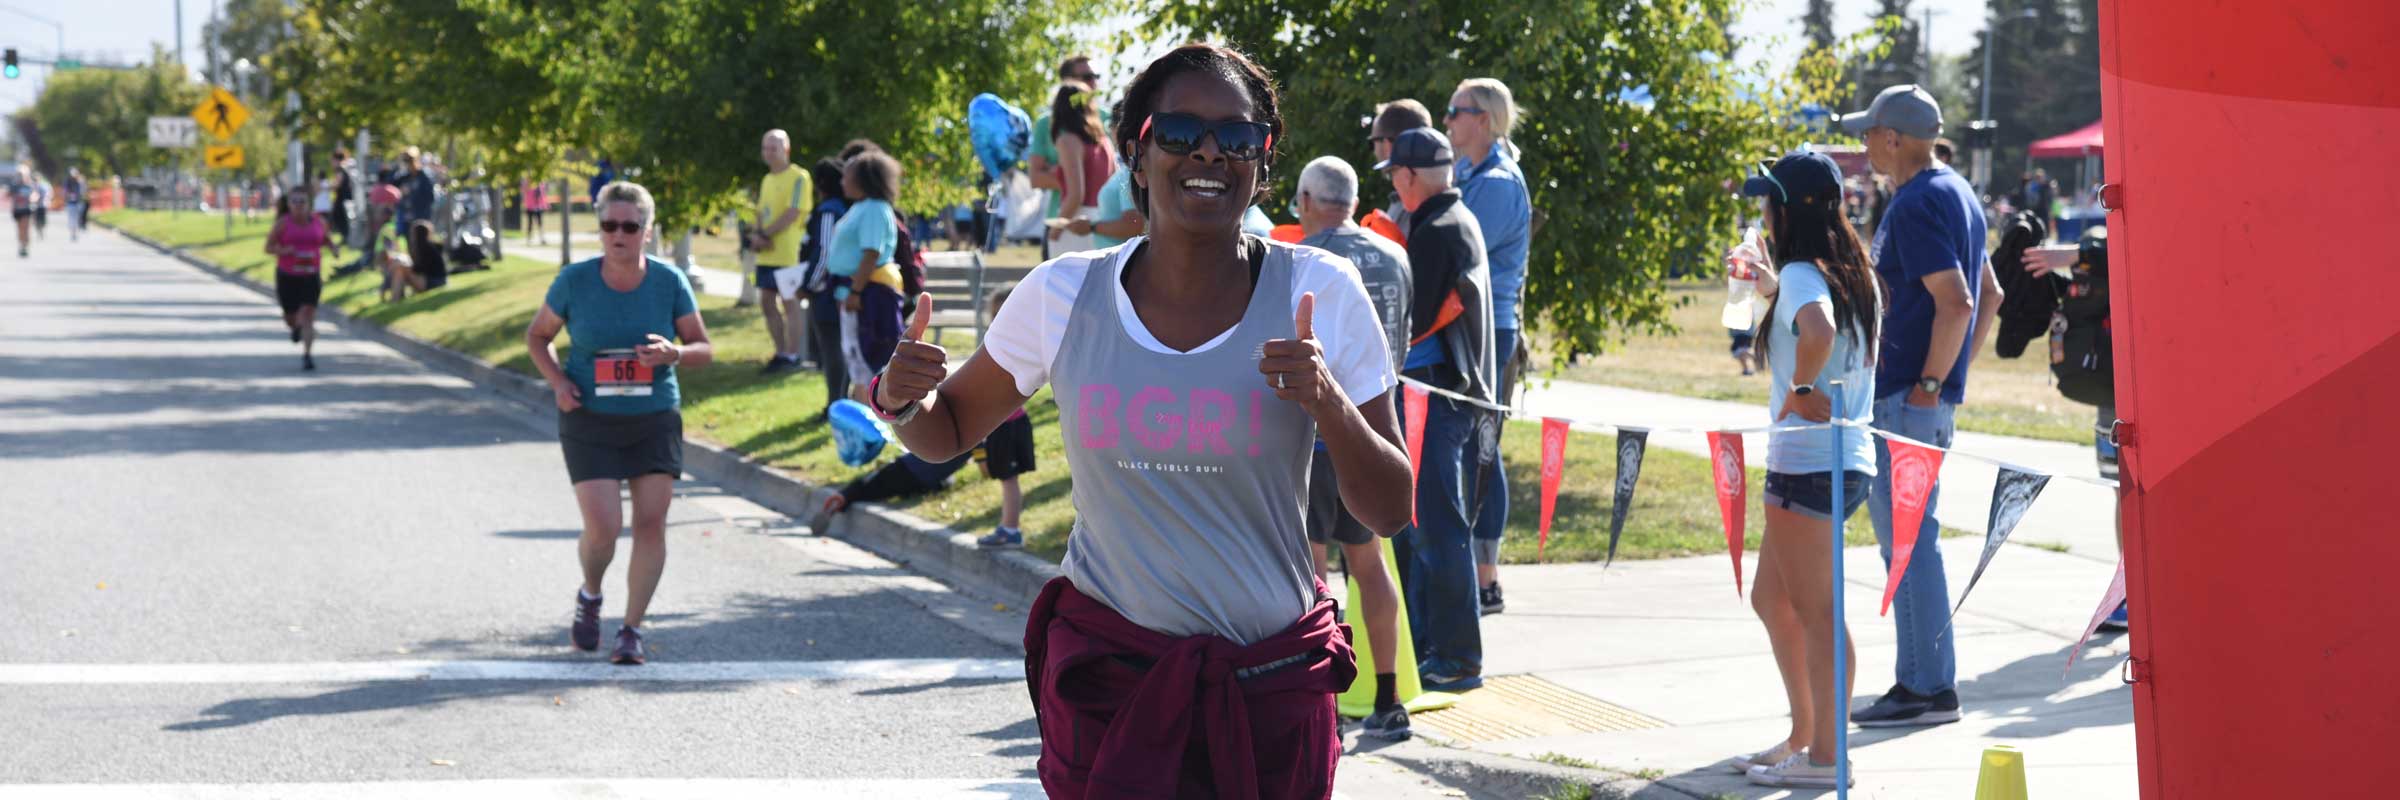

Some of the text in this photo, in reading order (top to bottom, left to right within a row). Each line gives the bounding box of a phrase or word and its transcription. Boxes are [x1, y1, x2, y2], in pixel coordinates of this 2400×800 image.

[614, 360, 635, 381] 66
[1078, 383, 1264, 457] BGR!
[1117, 460, 1149, 470] BLACK
[1156, 463, 1189, 473] GIRLS
